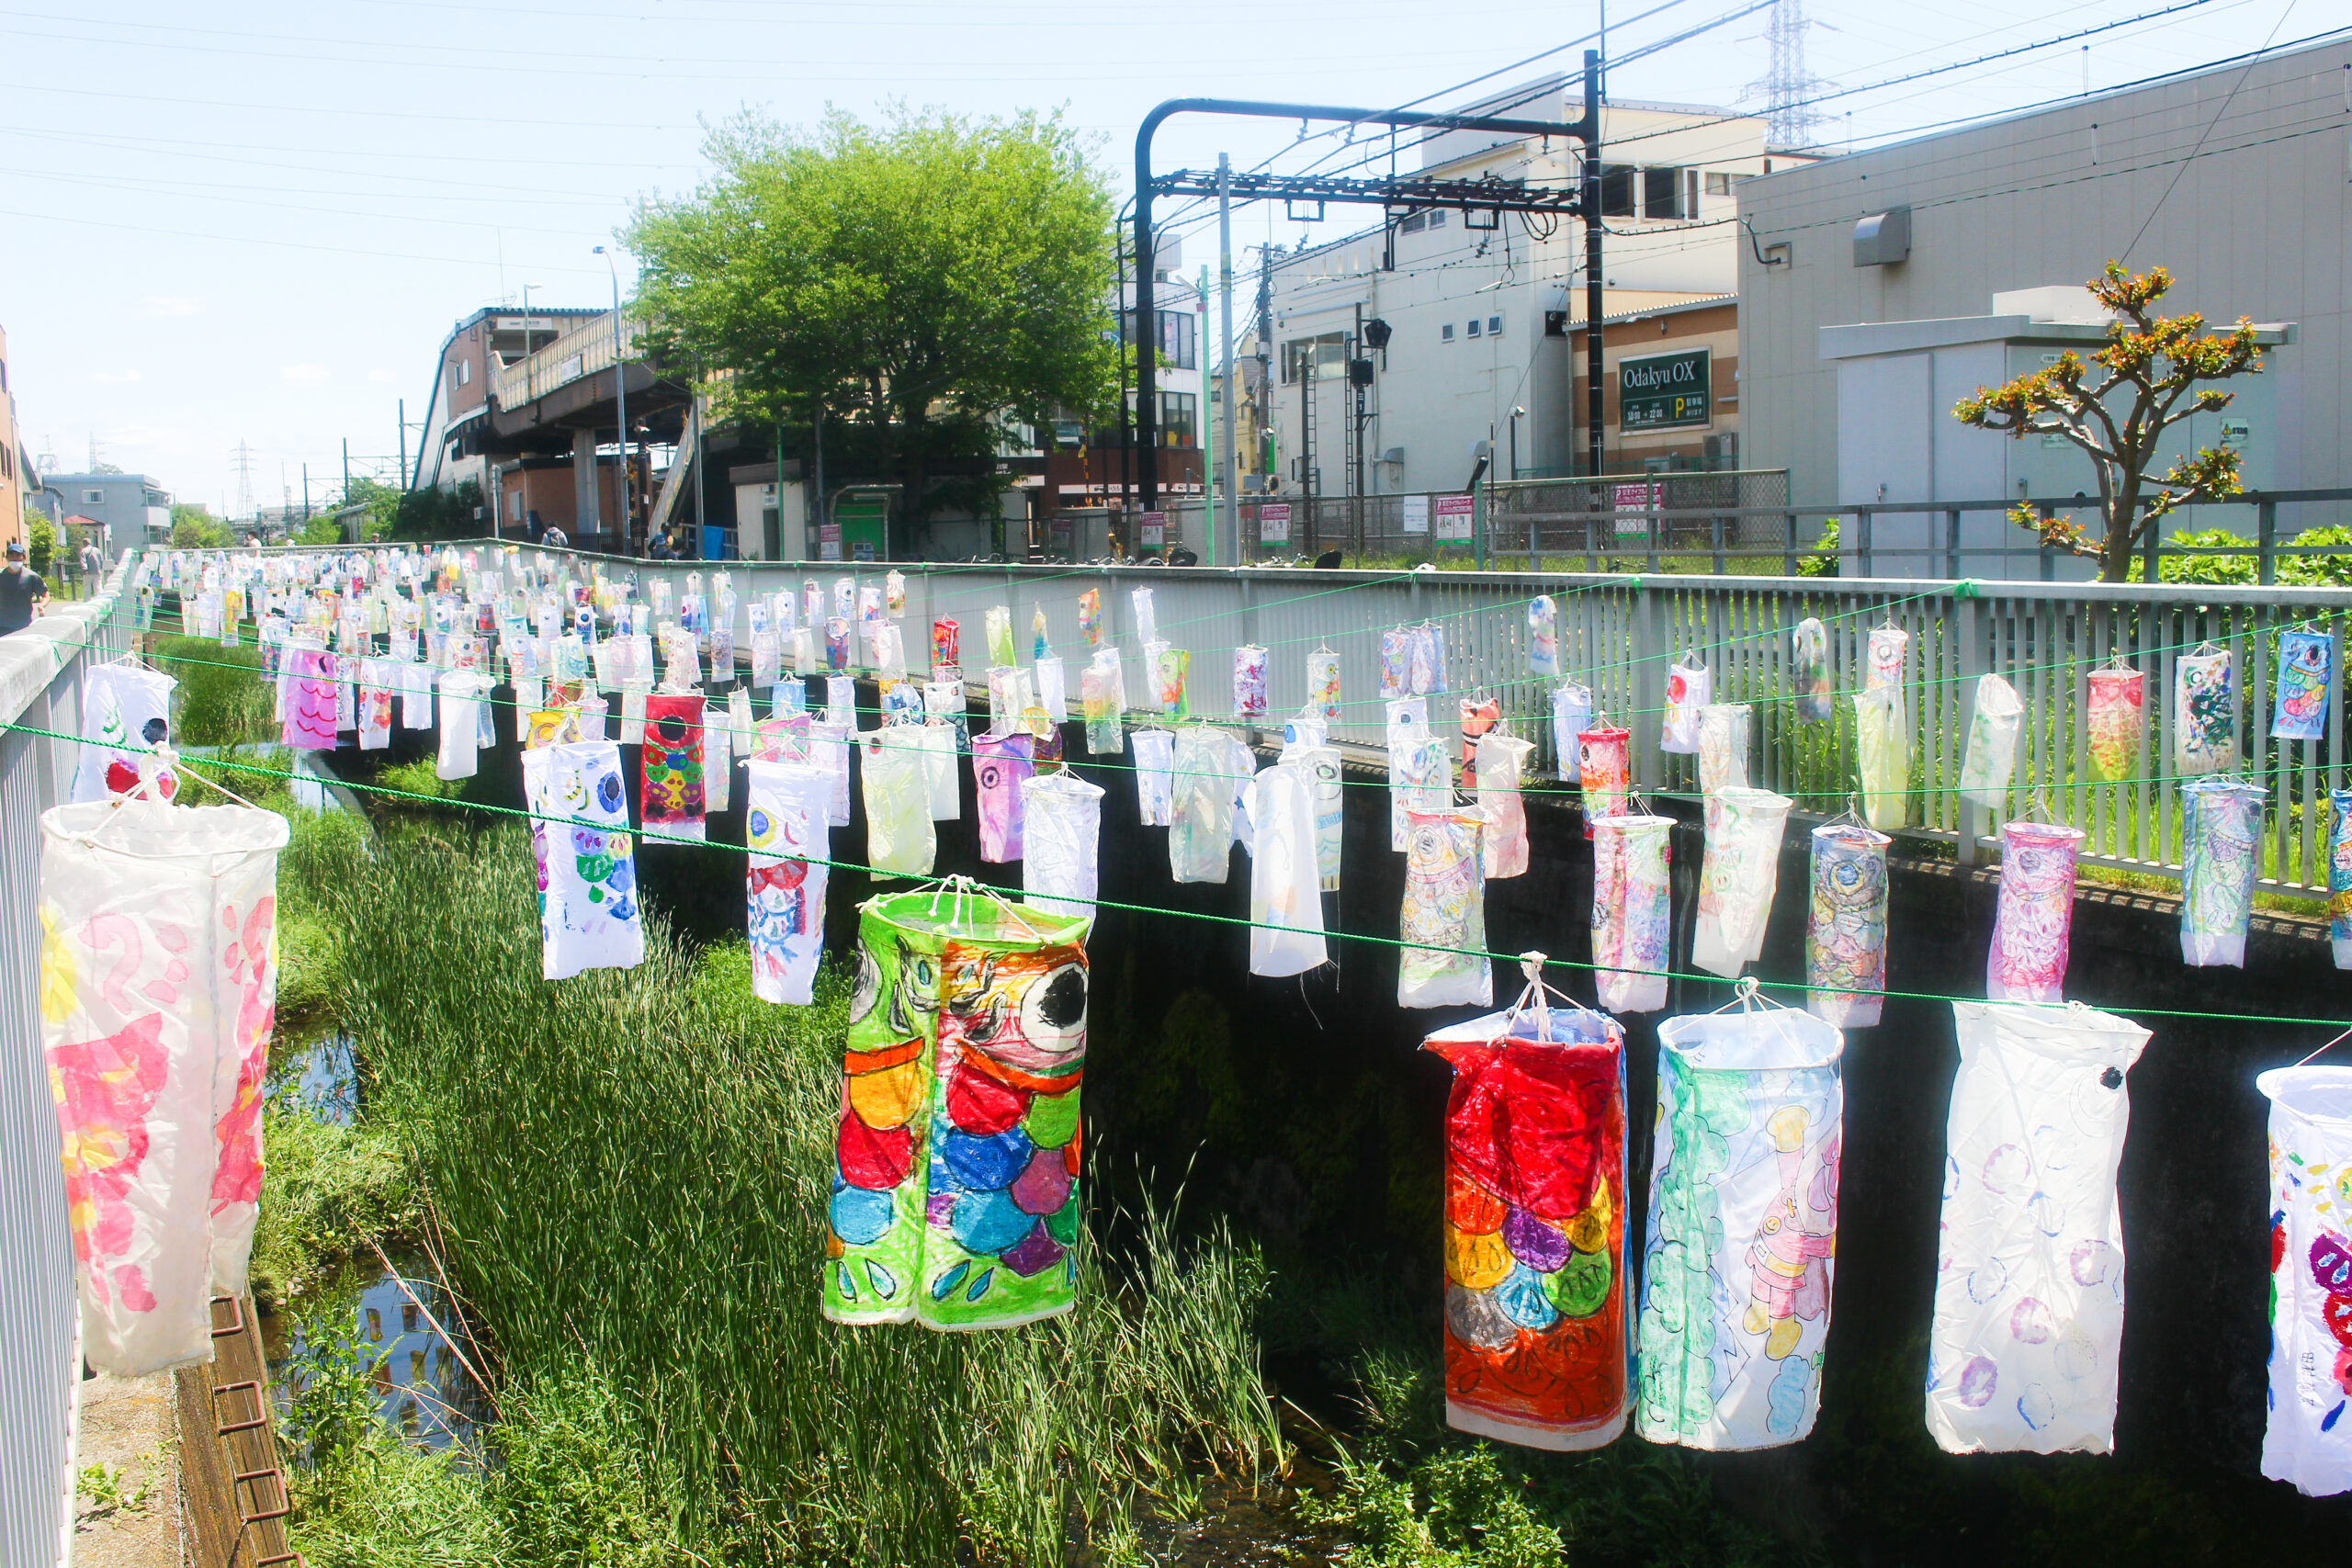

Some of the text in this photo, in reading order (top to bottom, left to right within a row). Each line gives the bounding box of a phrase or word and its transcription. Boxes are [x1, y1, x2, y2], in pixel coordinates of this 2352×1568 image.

[1624, 360, 1695, 389] Odakyu OX
[1675, 397, 1685, 419] P
